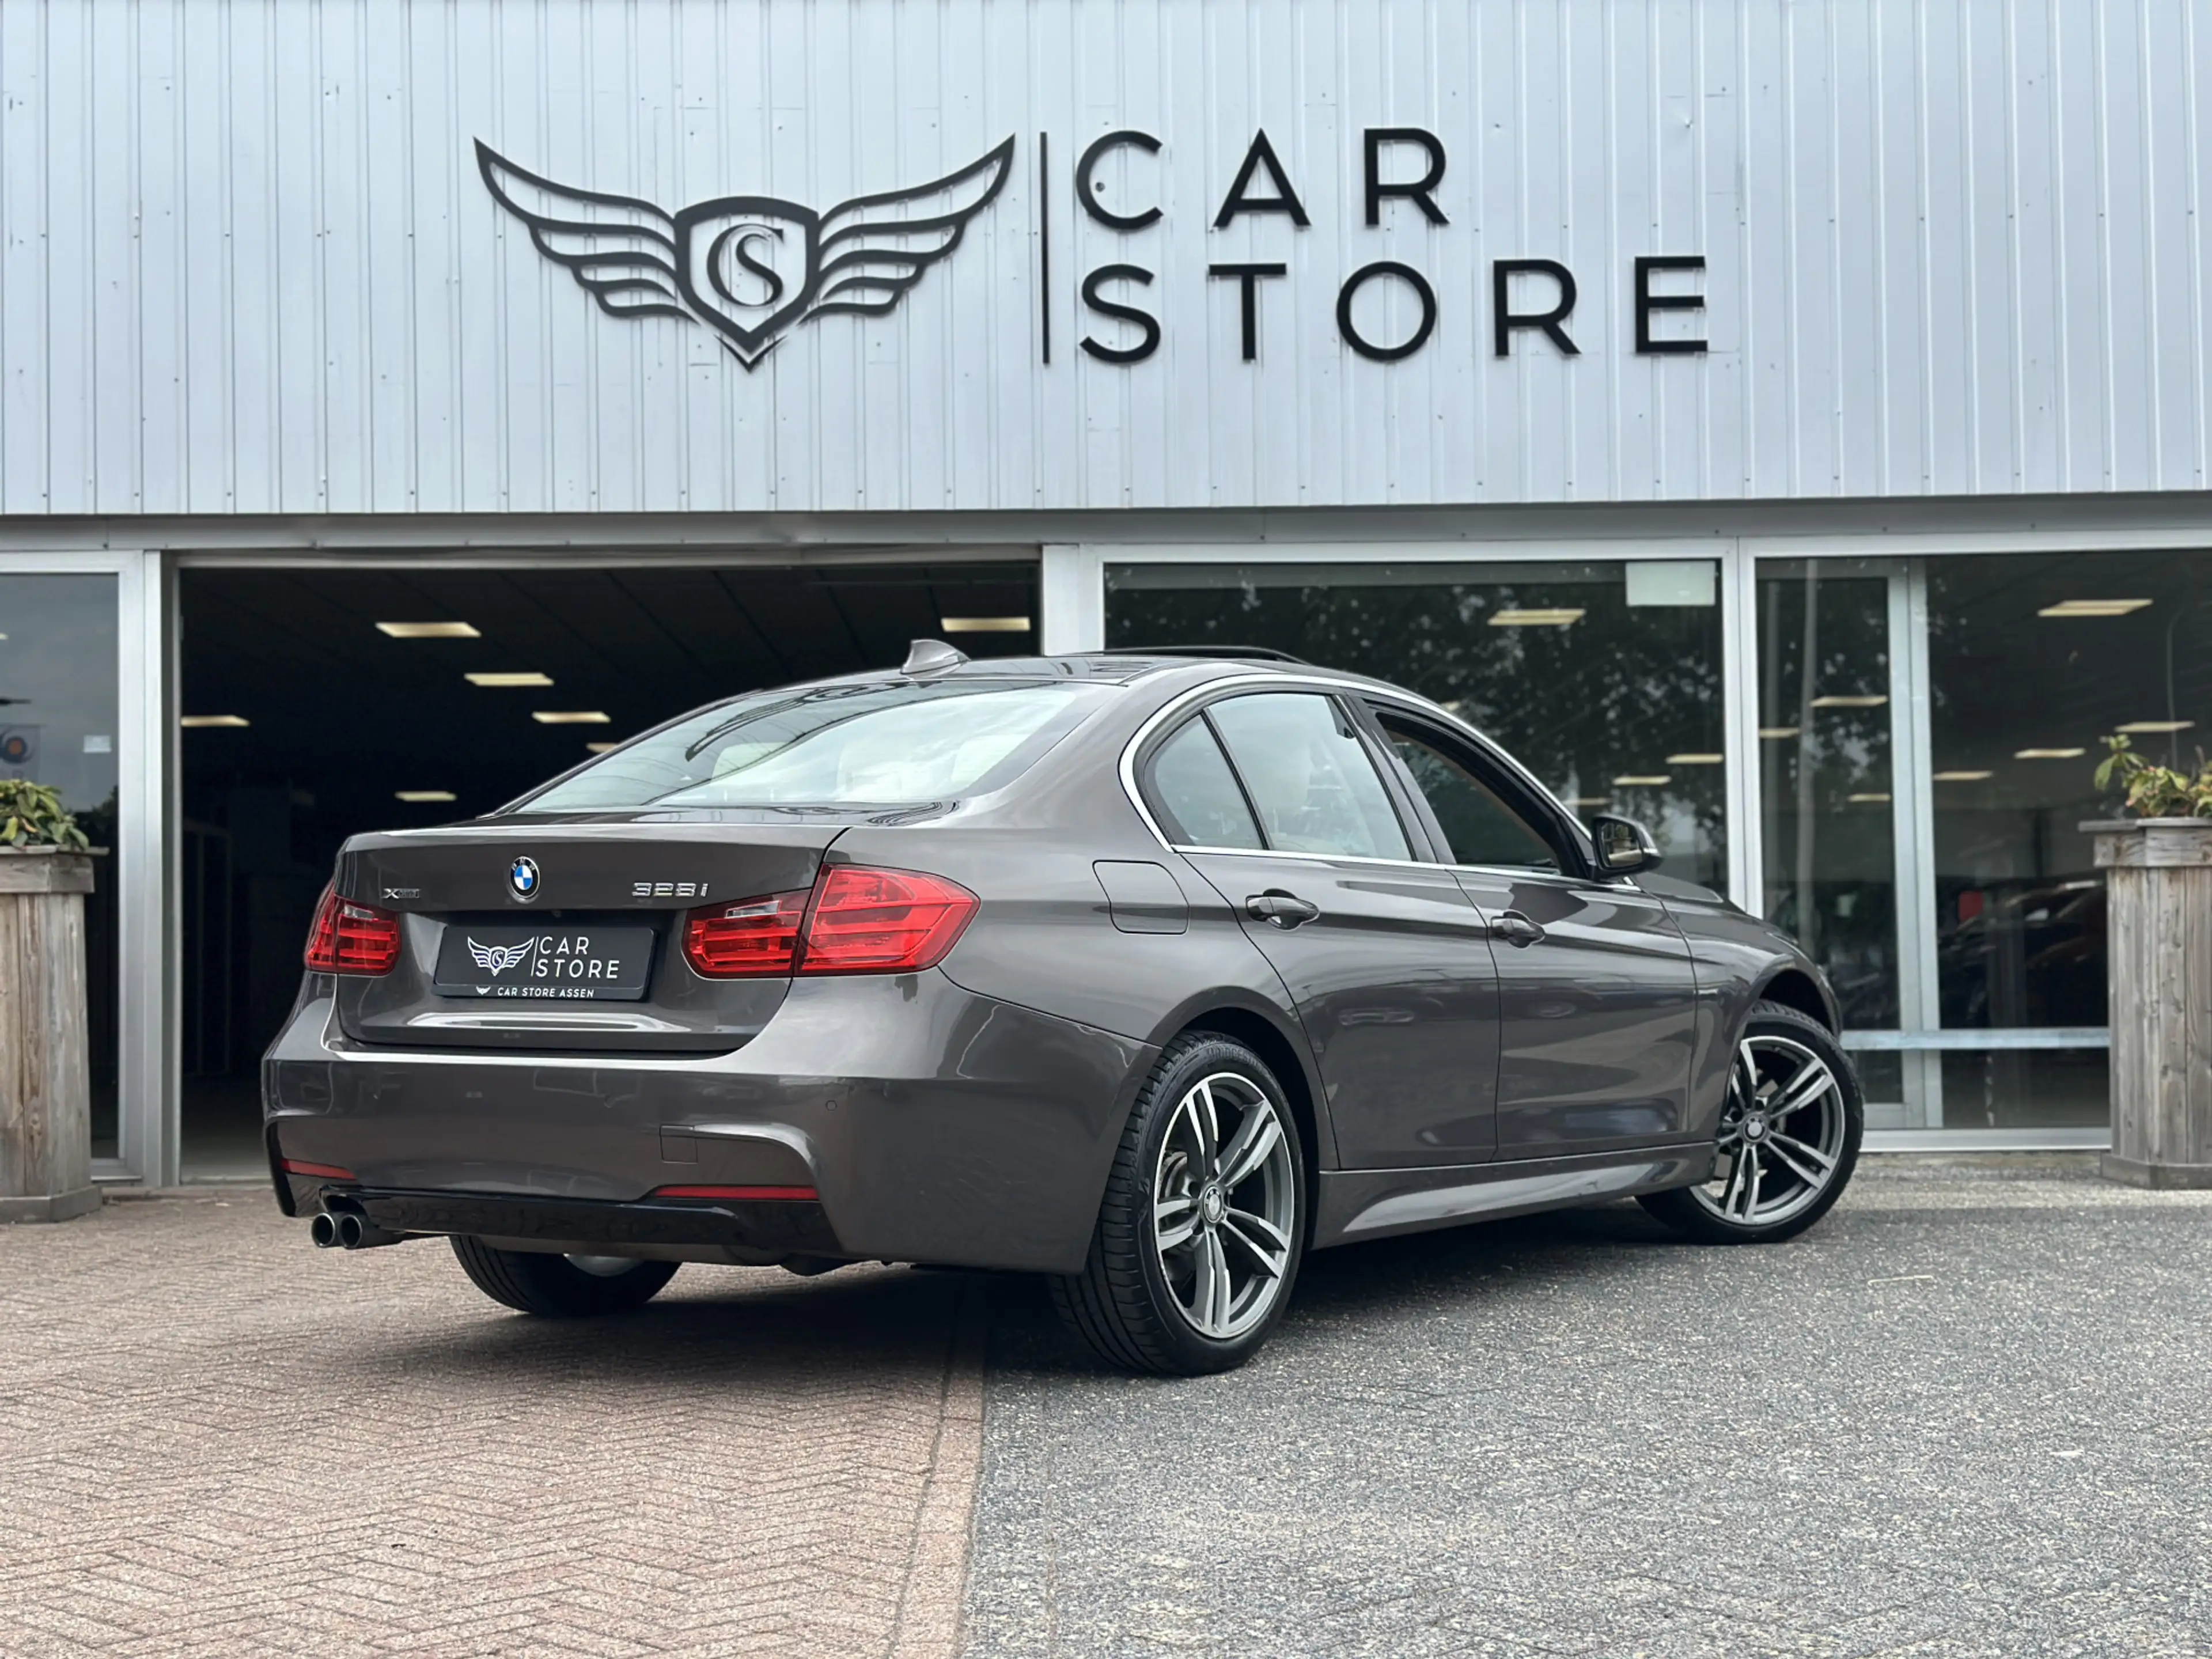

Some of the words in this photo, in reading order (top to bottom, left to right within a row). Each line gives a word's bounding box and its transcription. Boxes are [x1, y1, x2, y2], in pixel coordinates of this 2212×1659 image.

[1075, 127, 1450, 233] CAR
[1080, 255, 1708, 365] STORE
[631, 882, 709, 897] 328i
[539, 935, 590, 955] CAR
[535, 958, 620, 979] STORE
[497, 986, 518, 997] CAR
[521, 987, 556, 998] STORE
[558, 988, 595, 998] ASSEN
